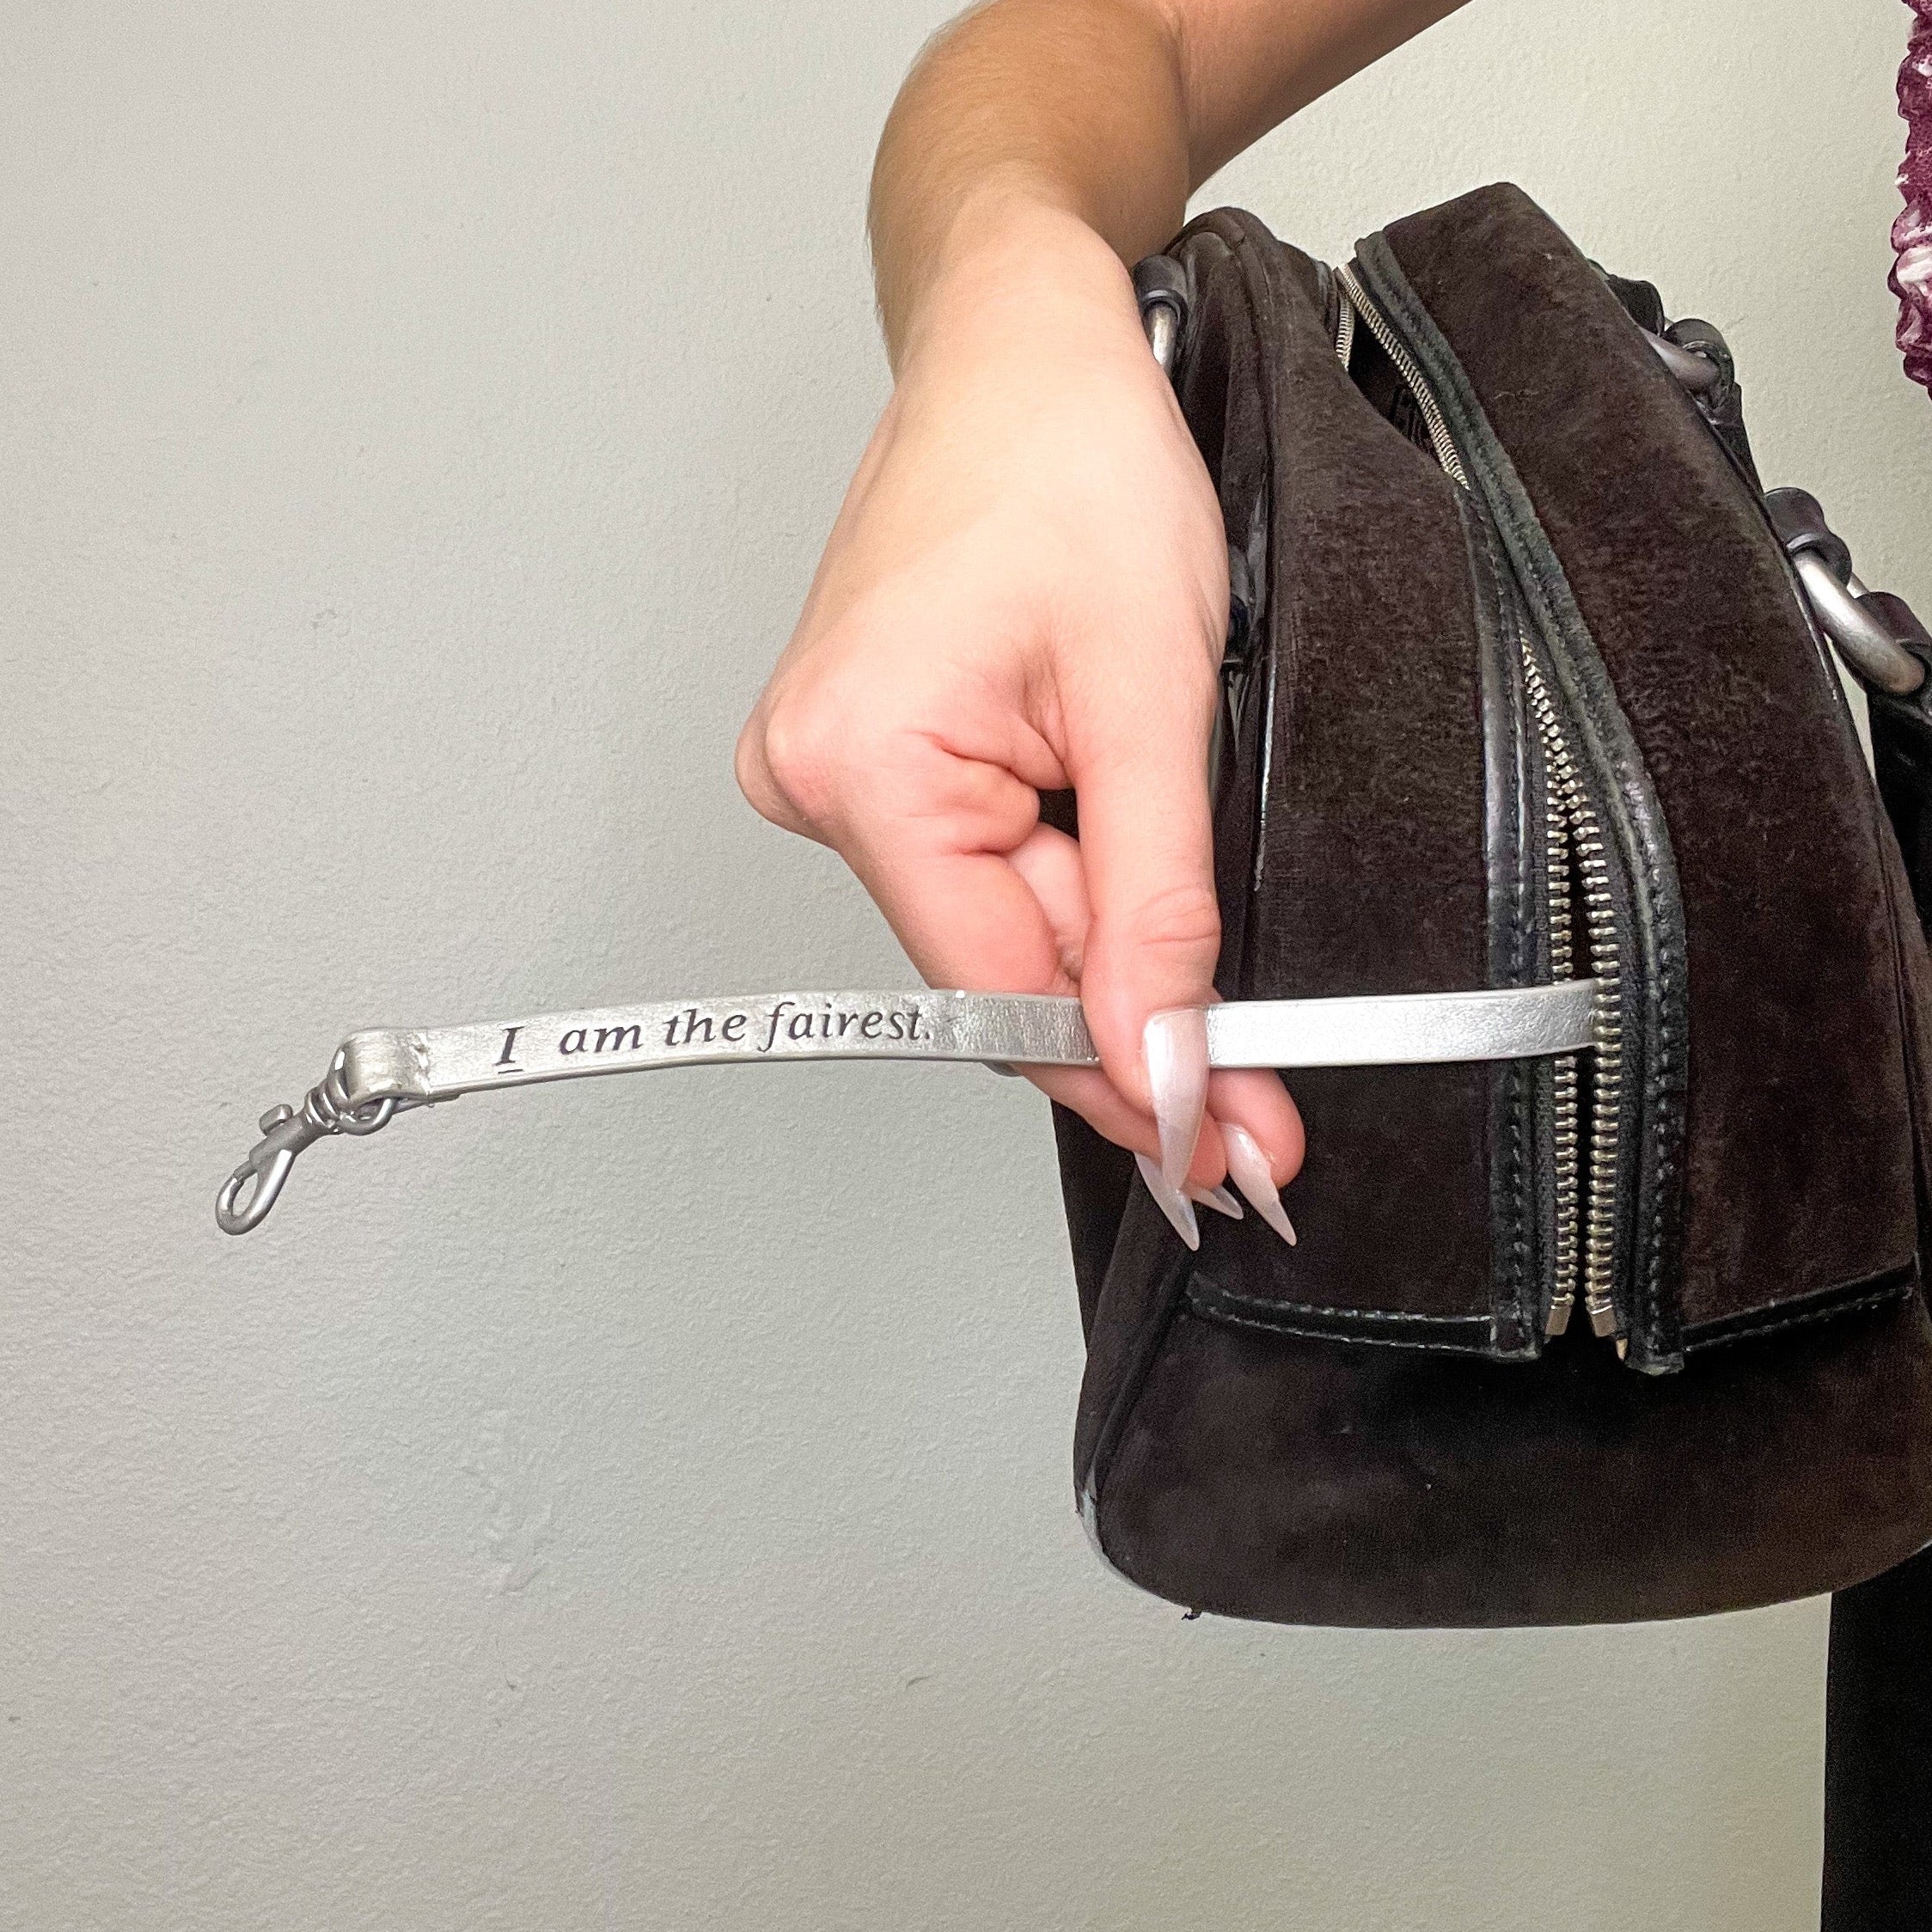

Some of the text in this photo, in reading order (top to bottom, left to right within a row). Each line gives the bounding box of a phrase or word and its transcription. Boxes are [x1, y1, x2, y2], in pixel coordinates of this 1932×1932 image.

[494, 1001, 932, 1067] I am the fairest.
